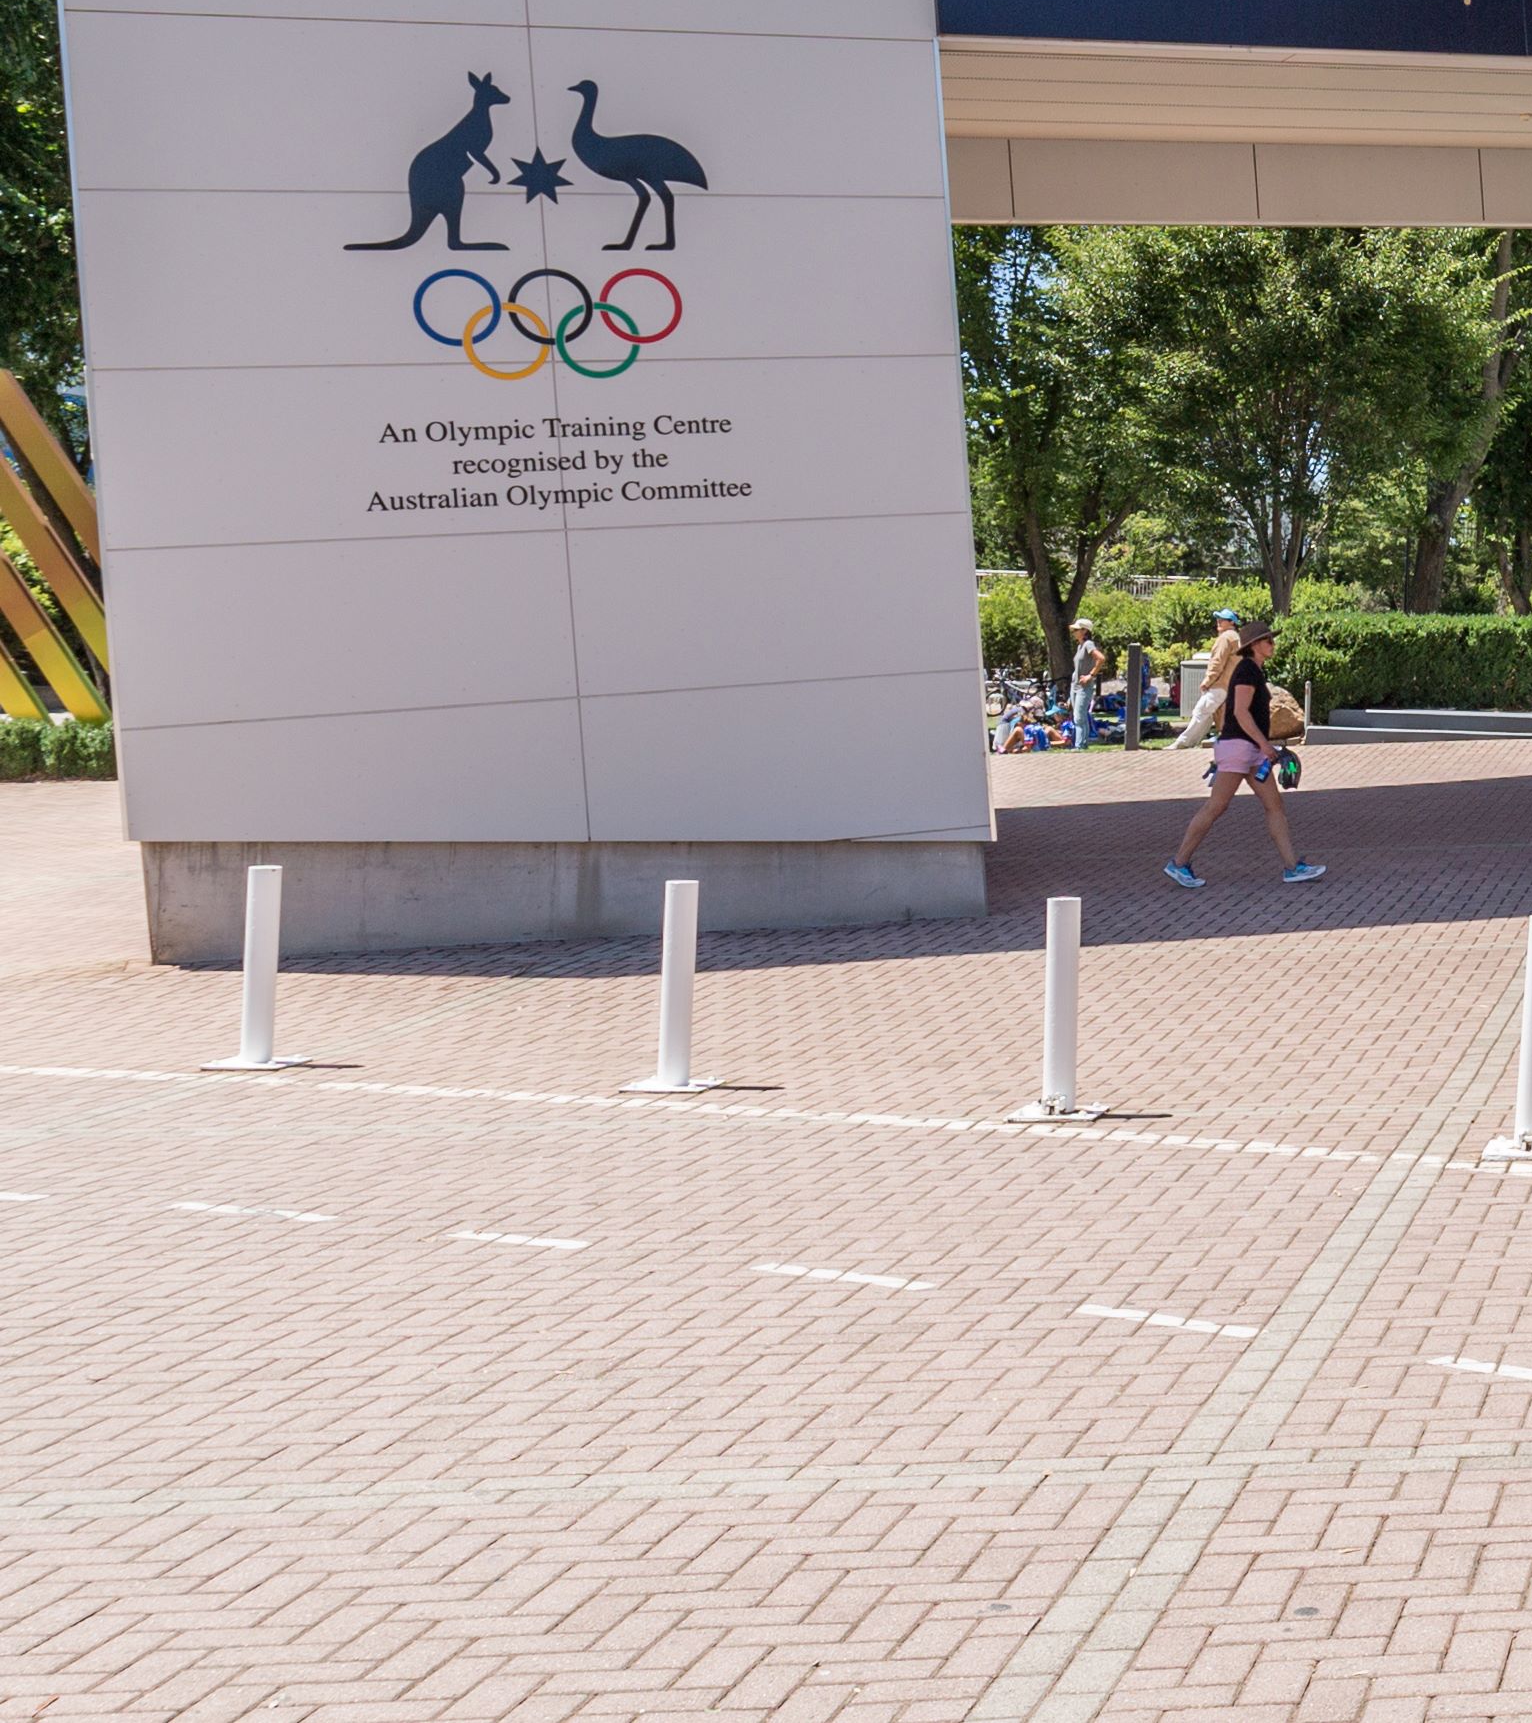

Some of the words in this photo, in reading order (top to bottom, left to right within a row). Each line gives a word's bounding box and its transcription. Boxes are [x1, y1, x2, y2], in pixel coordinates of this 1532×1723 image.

[379, 422, 417, 444] An
[425, 419, 535, 447] Olympic
[542, 416, 646, 441] Training
[653, 414, 732, 436] Centre
[452, 450, 587, 479] recognised
[594, 449, 624, 475] by
[632, 448, 669, 468] the
[367, 487, 498, 512] Australian
[506, 482, 613, 511] Olympic
[621, 478, 752, 502] Committee
